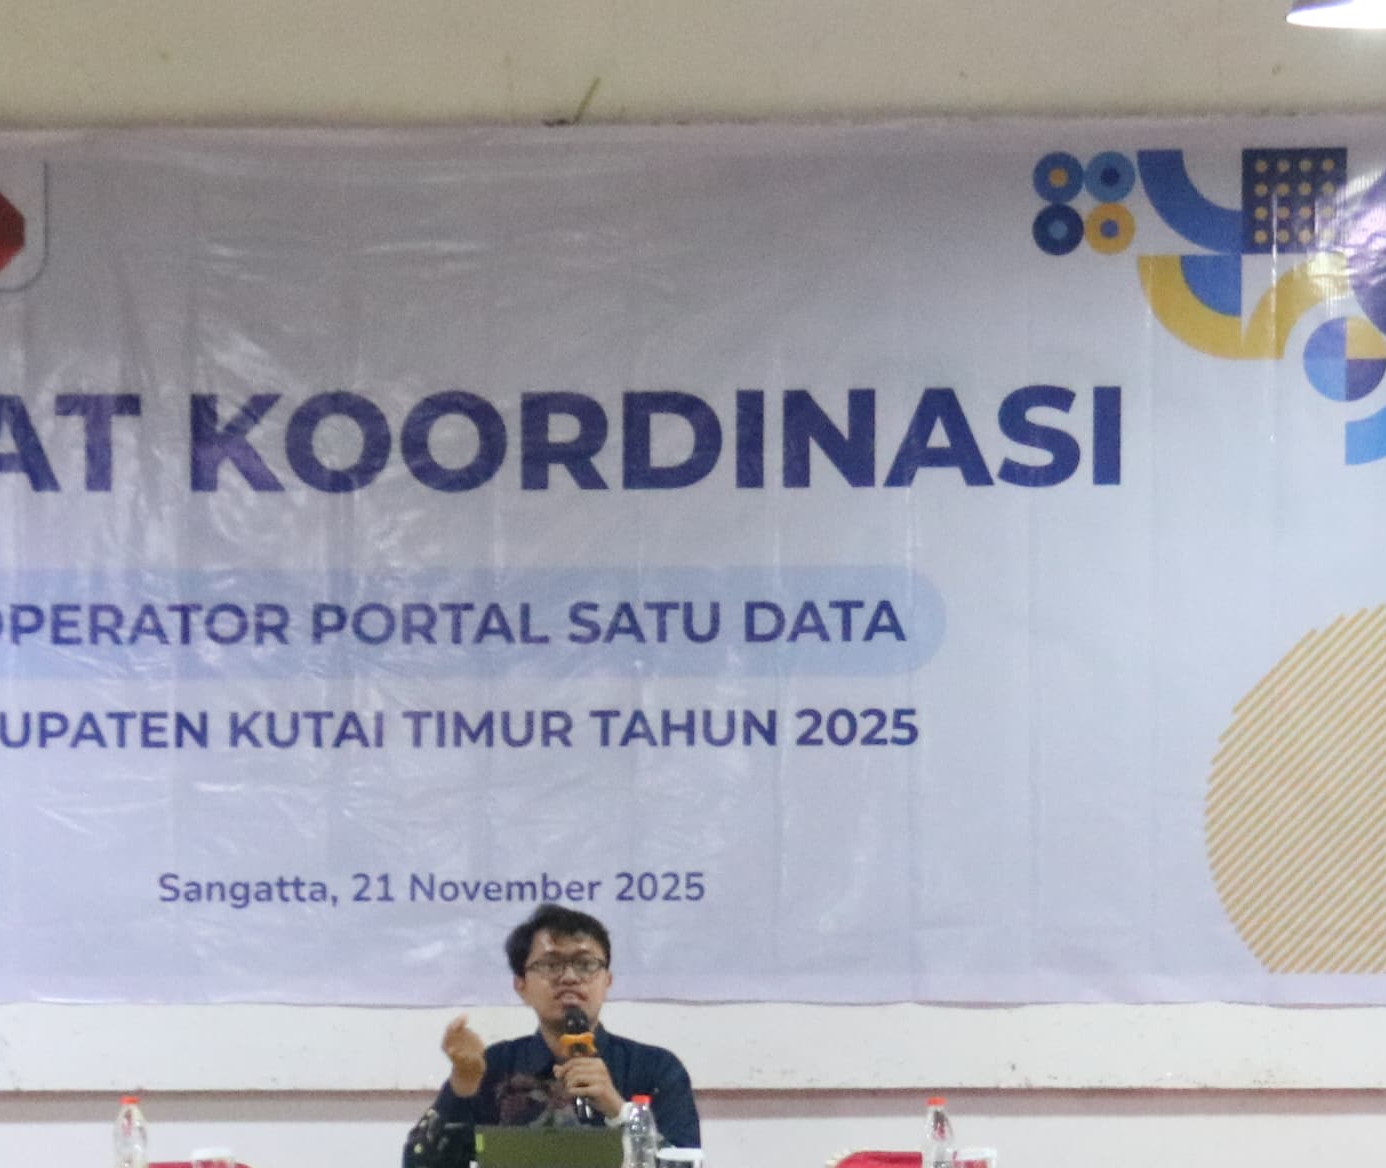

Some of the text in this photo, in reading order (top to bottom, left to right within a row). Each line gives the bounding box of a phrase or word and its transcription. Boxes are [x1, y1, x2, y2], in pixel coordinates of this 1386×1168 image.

[189, 384, 1123, 495] KOORDINASI
[312, 602, 550, 646] PORTAL
[568, 601, 721, 645] SATU
[744, 599, 907, 643] DATA
[229, 710, 384, 750] KUTAI
[402, 709, 574, 749] TIMUR
[588, 708, 778, 748] TAHUN
[795, 707, 920, 747] 2025
[158, 871, 705, 909] Sangatta, 21 November 2025
